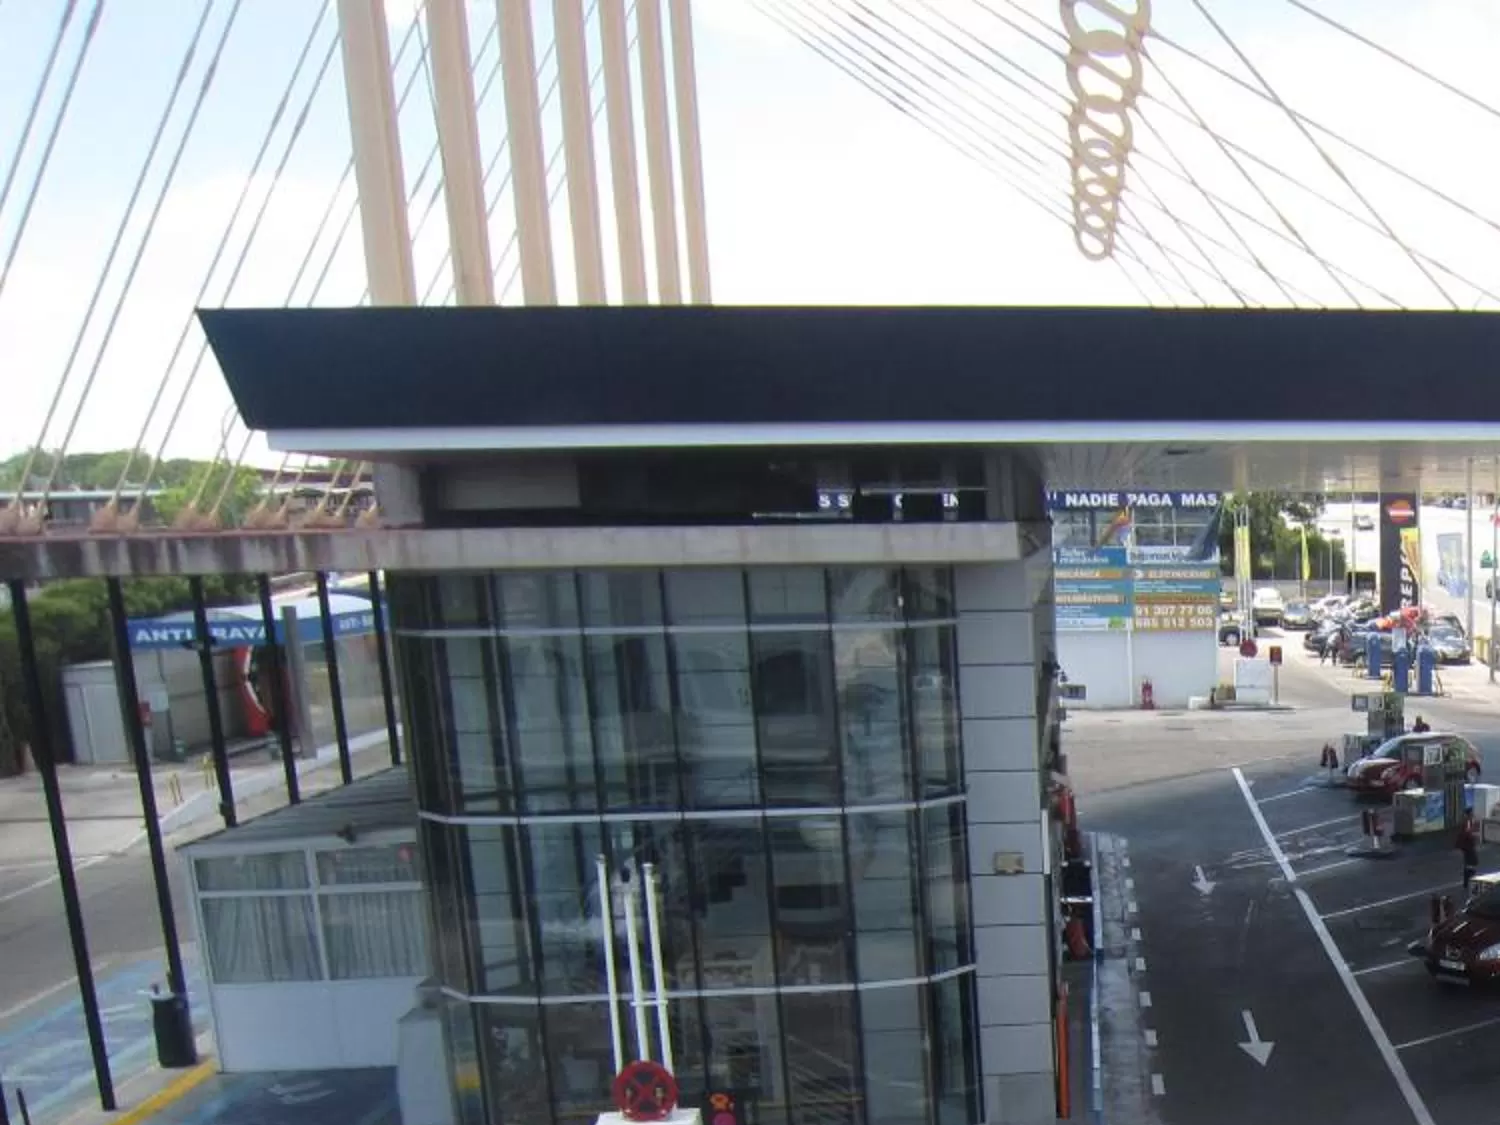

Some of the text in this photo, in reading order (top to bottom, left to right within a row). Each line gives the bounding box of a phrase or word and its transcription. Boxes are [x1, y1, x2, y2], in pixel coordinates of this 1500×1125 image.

[1065, 492, 1119, 508] NADIE
[1126, 492, 1173, 508] PAGA
[135, 628, 193, 643] ANTI
